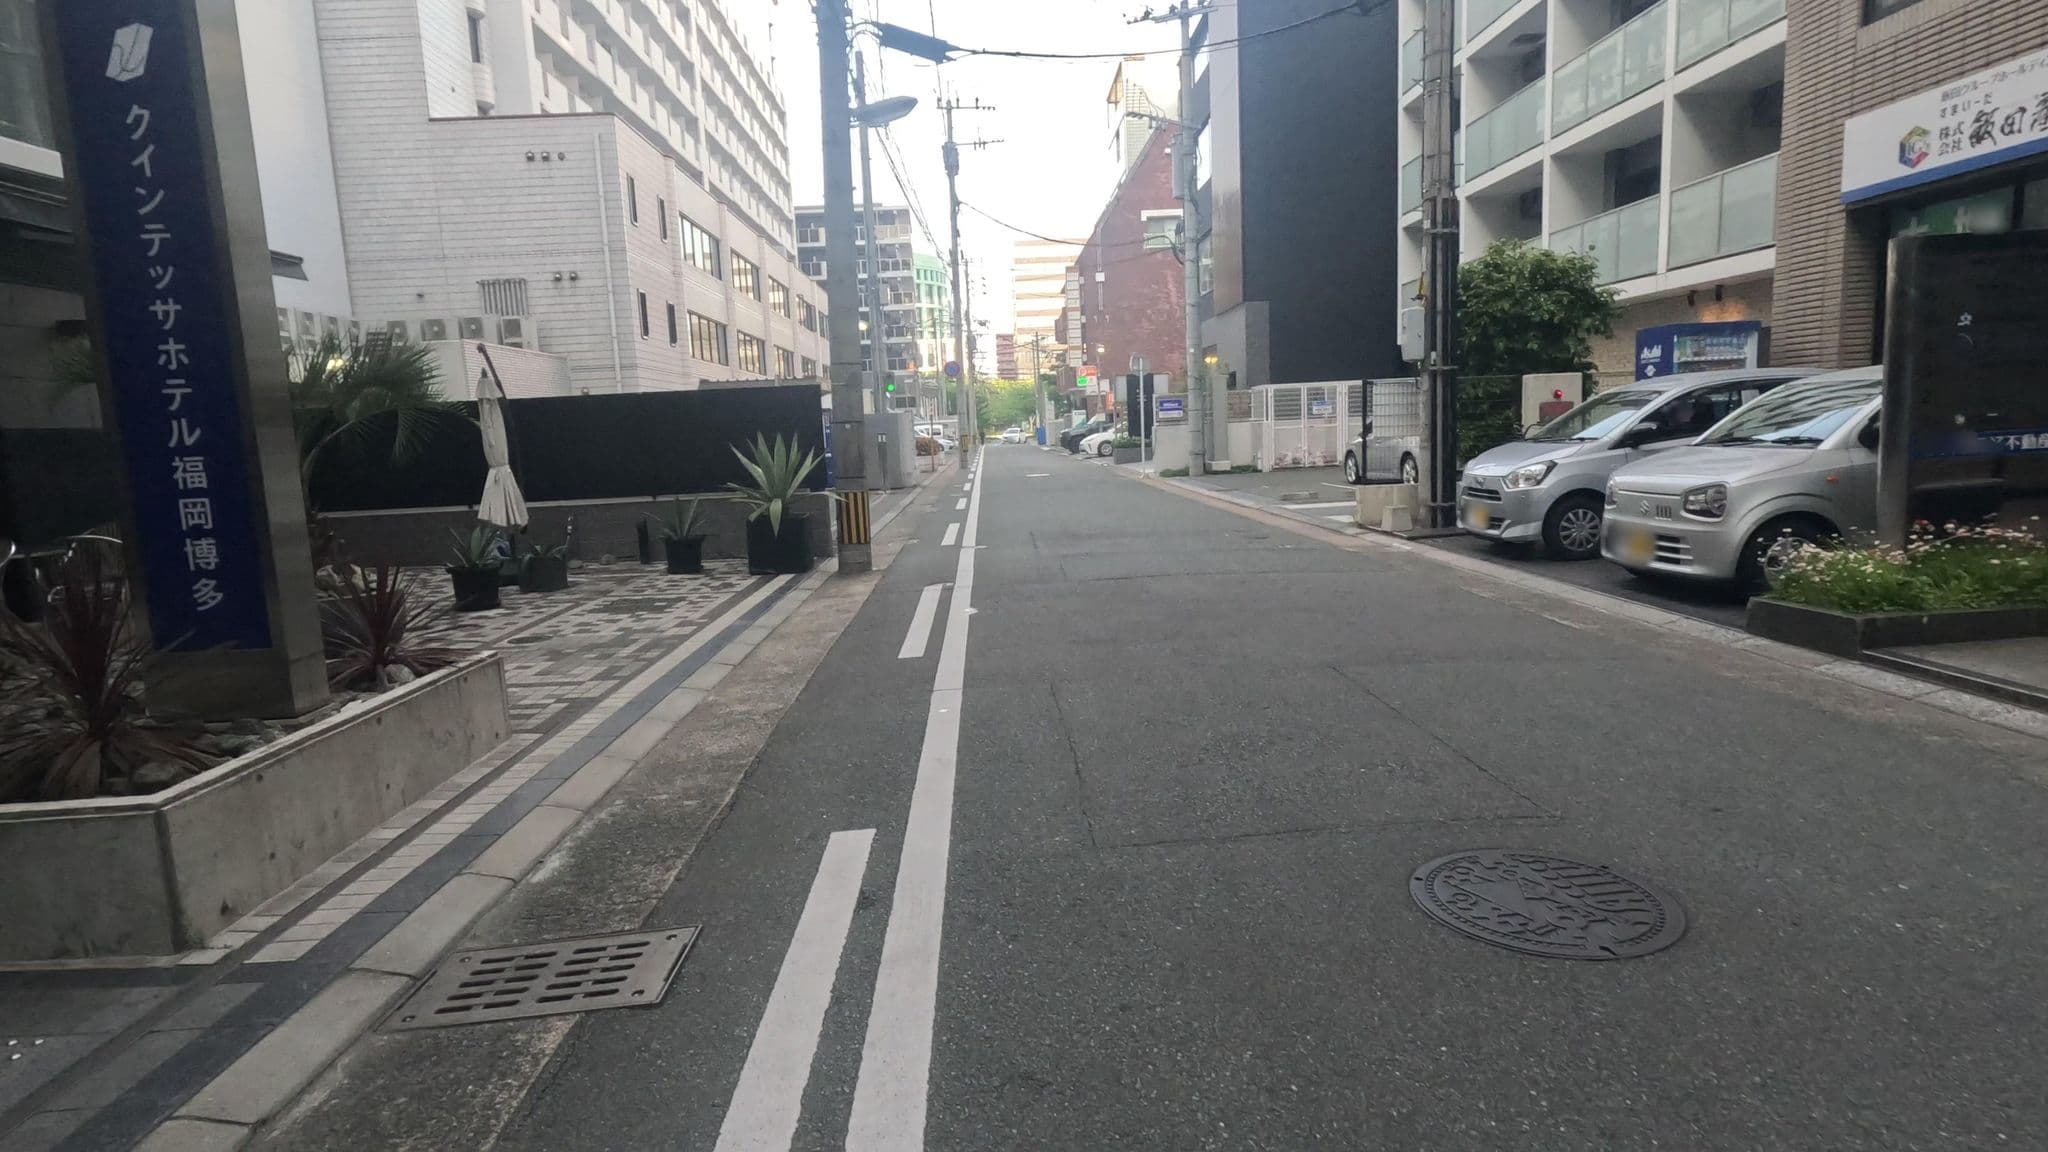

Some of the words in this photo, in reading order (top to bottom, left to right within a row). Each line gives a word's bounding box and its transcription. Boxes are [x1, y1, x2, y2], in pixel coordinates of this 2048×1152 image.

[125, 104, 224, 612] クインテッサホテル福岡博多
